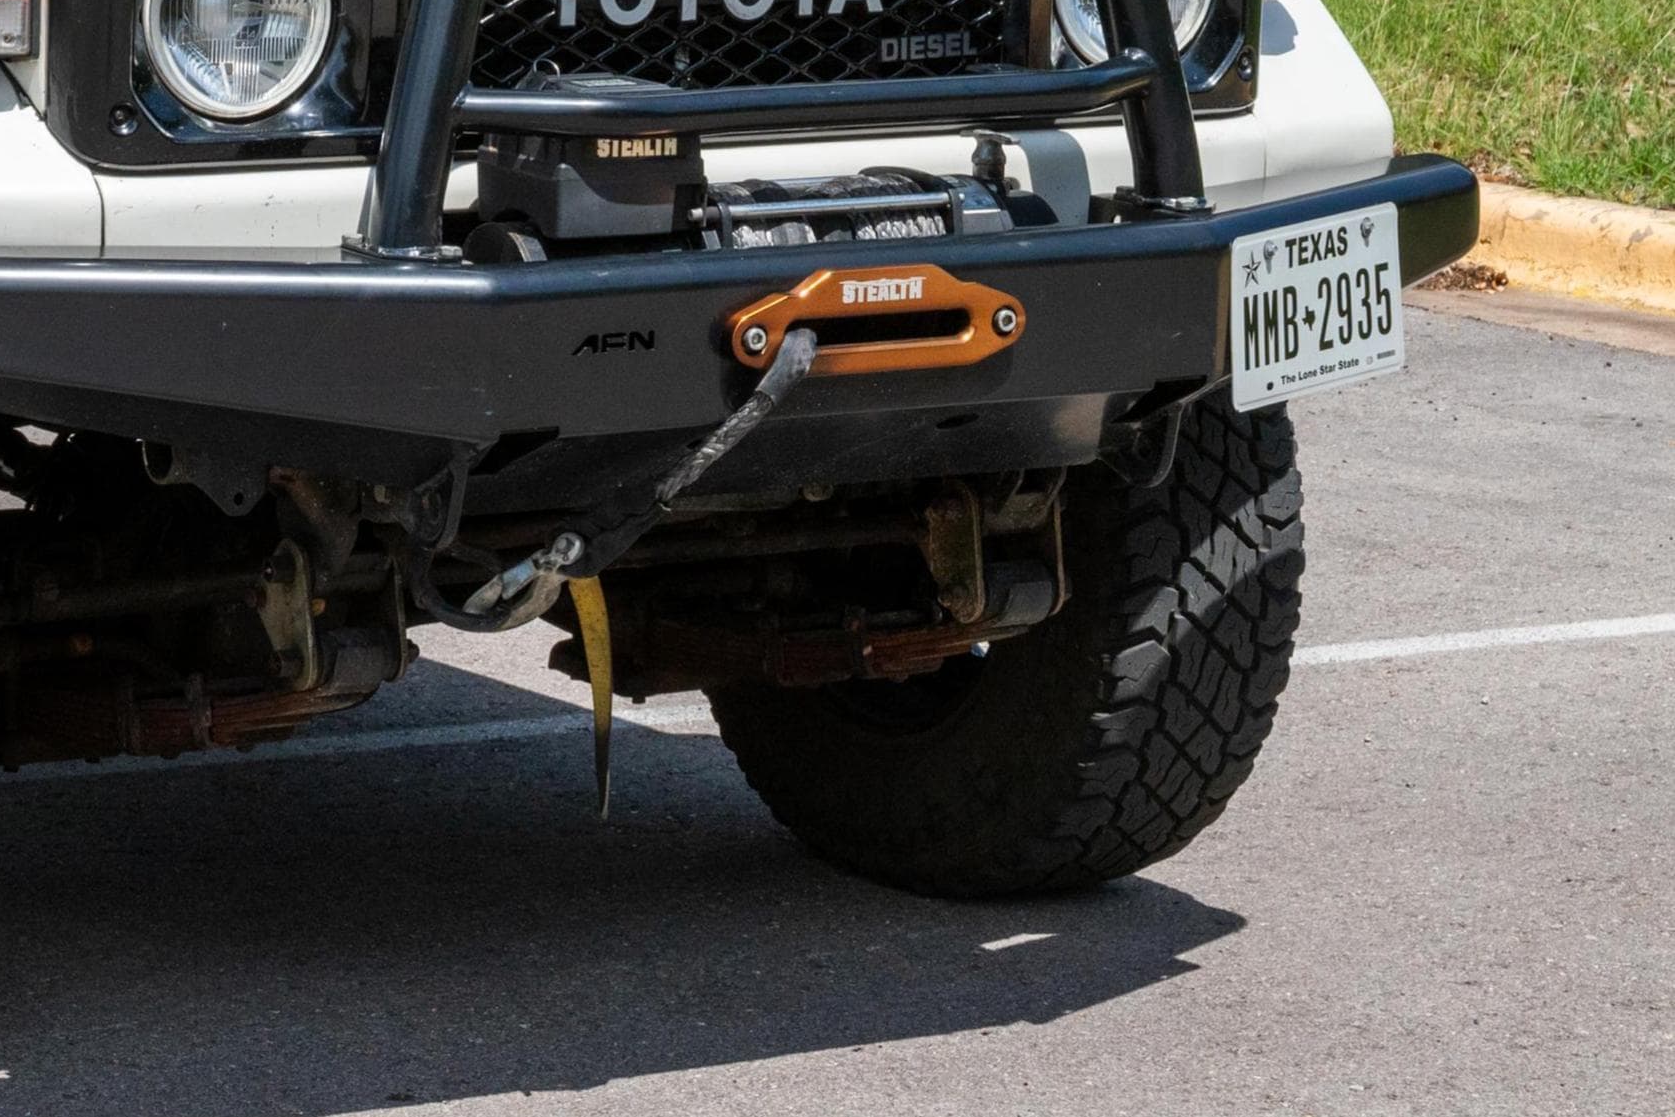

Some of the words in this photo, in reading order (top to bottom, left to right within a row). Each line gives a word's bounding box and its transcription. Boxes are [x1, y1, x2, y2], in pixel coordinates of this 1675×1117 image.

[880, 30, 978, 63] DIESEL
[596, 137, 678, 158] STEALTH
[1284, 226, 1349, 269] TEXAS
[841, 277, 924, 304] STEALTH
[571, 330, 655, 356] AFN
[1281, 374, 1296, 385] The
[1298, 369, 1318, 381] Lone
[1319, 363, 1336, 376] Star
[1338, 358, 1360, 371] State
